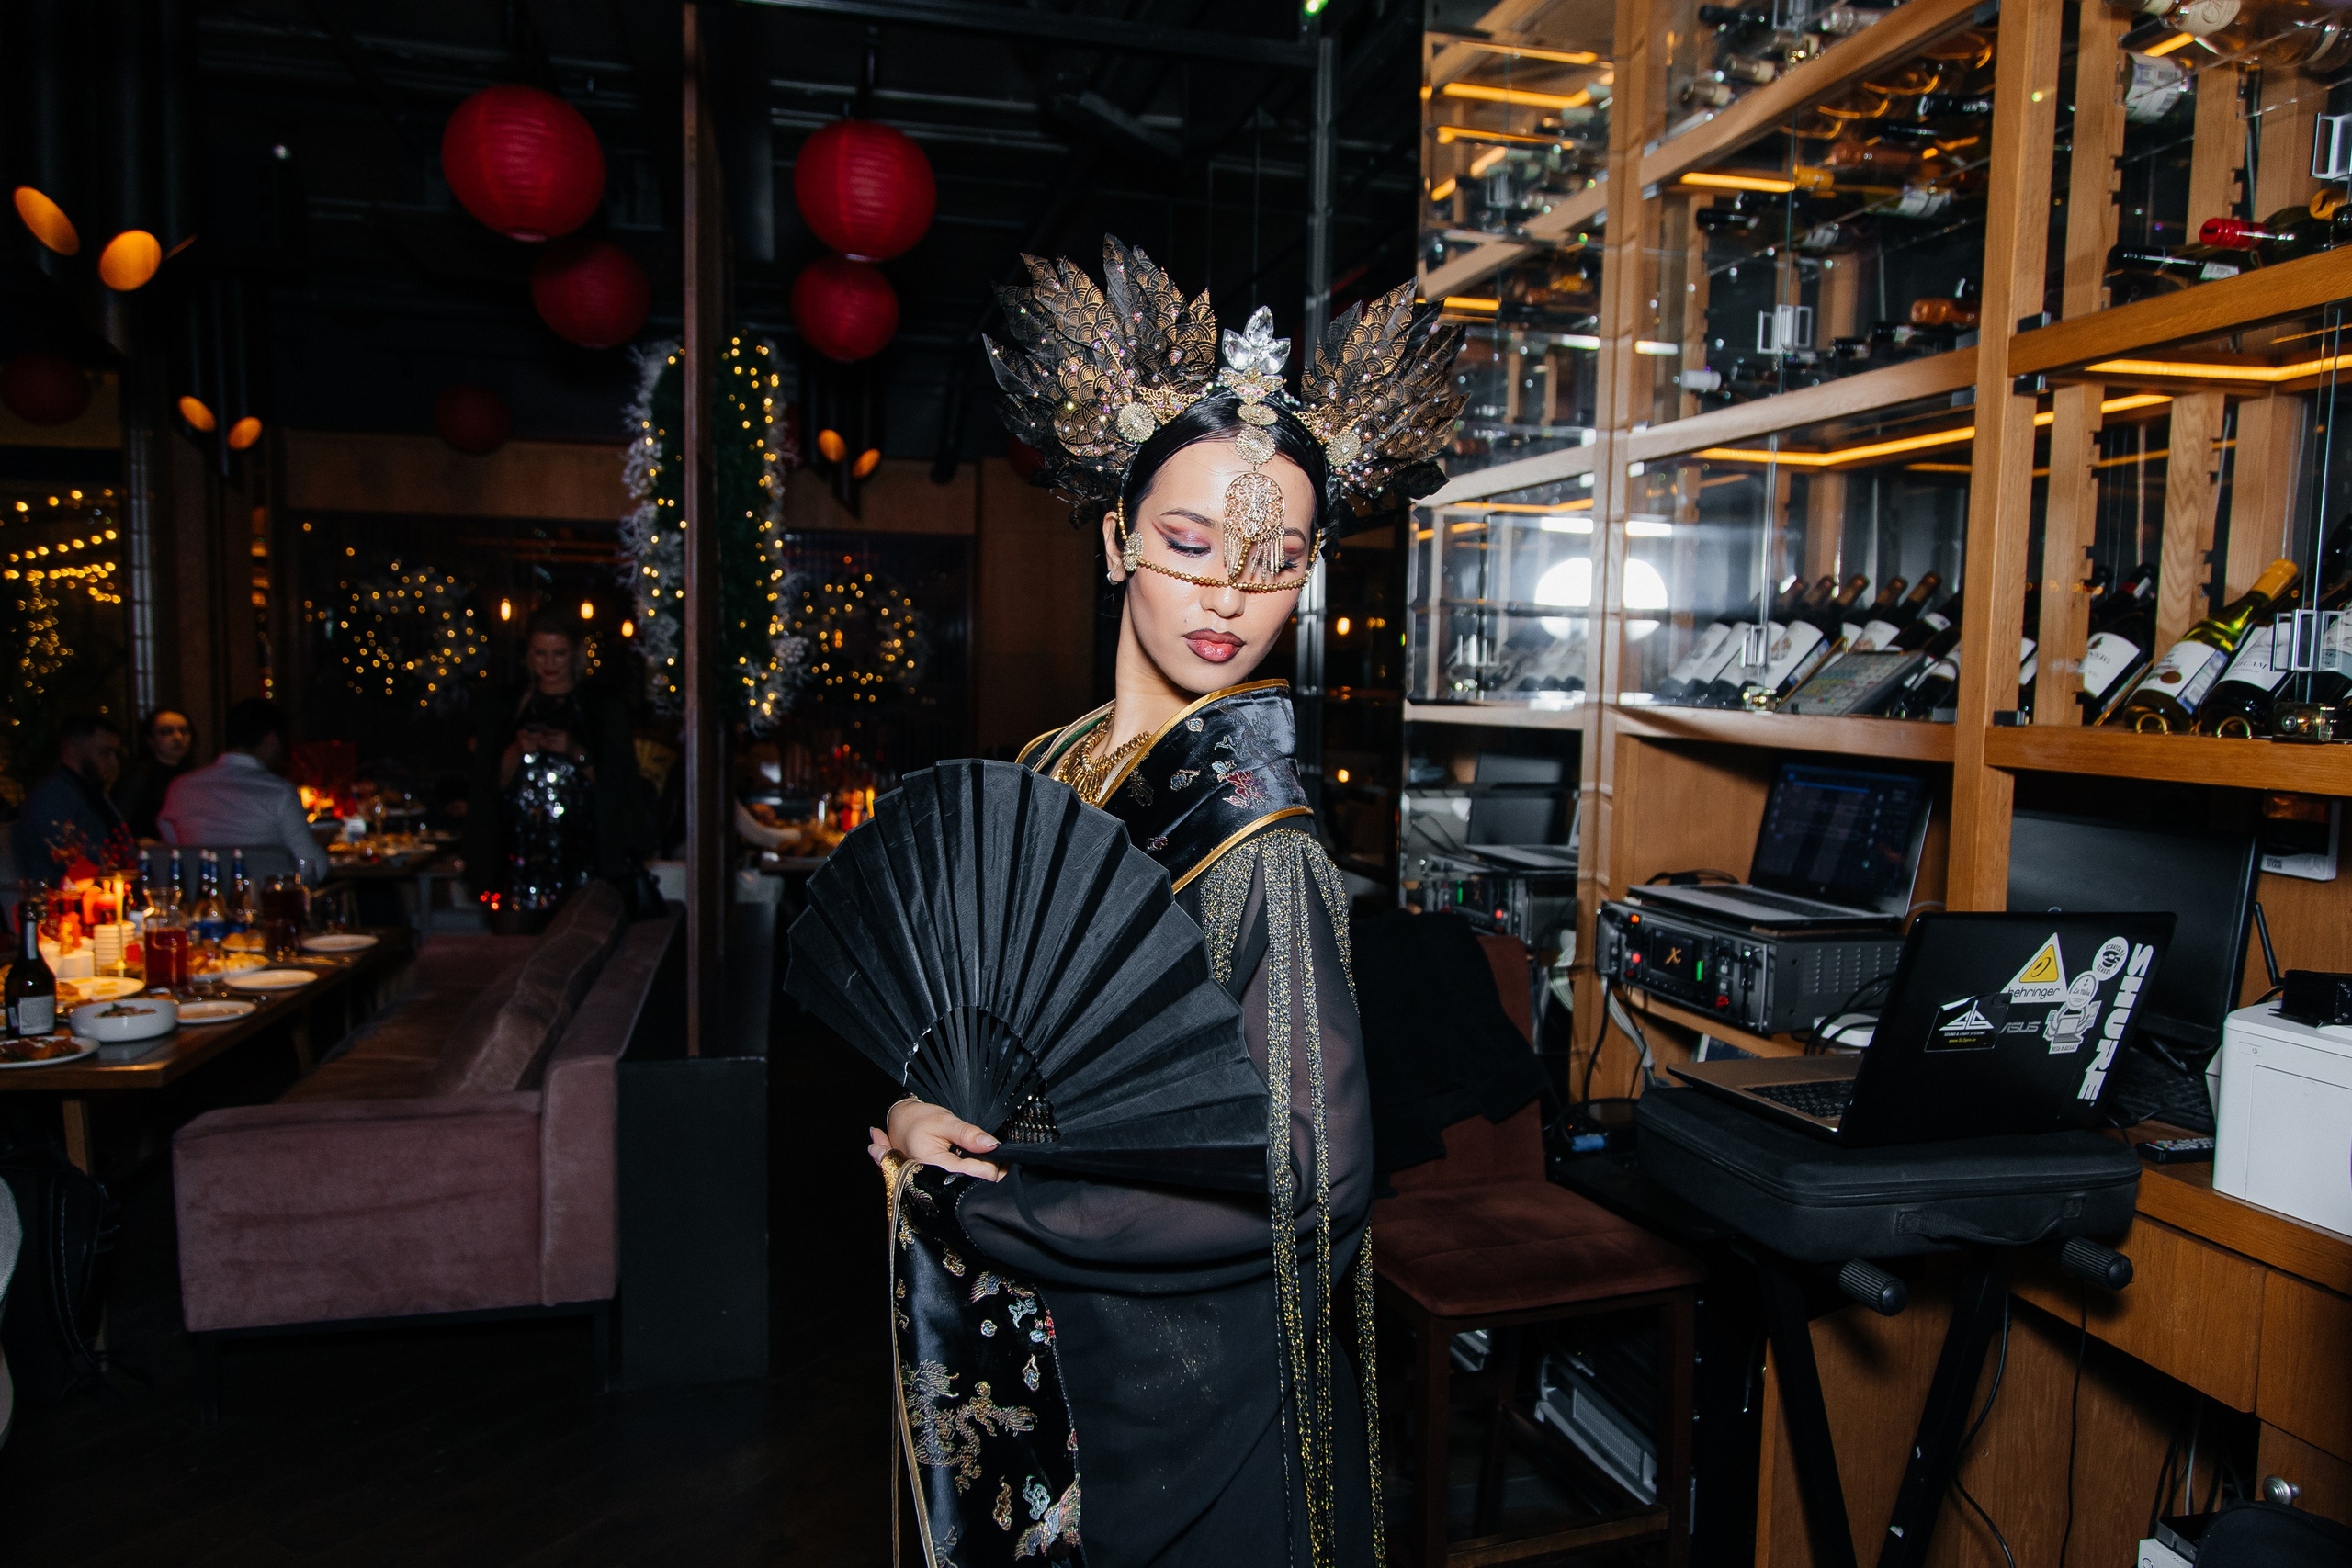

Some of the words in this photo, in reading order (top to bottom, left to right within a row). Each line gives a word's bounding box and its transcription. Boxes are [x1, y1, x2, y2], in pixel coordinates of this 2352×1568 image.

[2008, 987, 2061, 1000] behringer
[1999, 1021, 2041, 1034] ASUS
[2077, 942, 2154, 1100] SHURE
